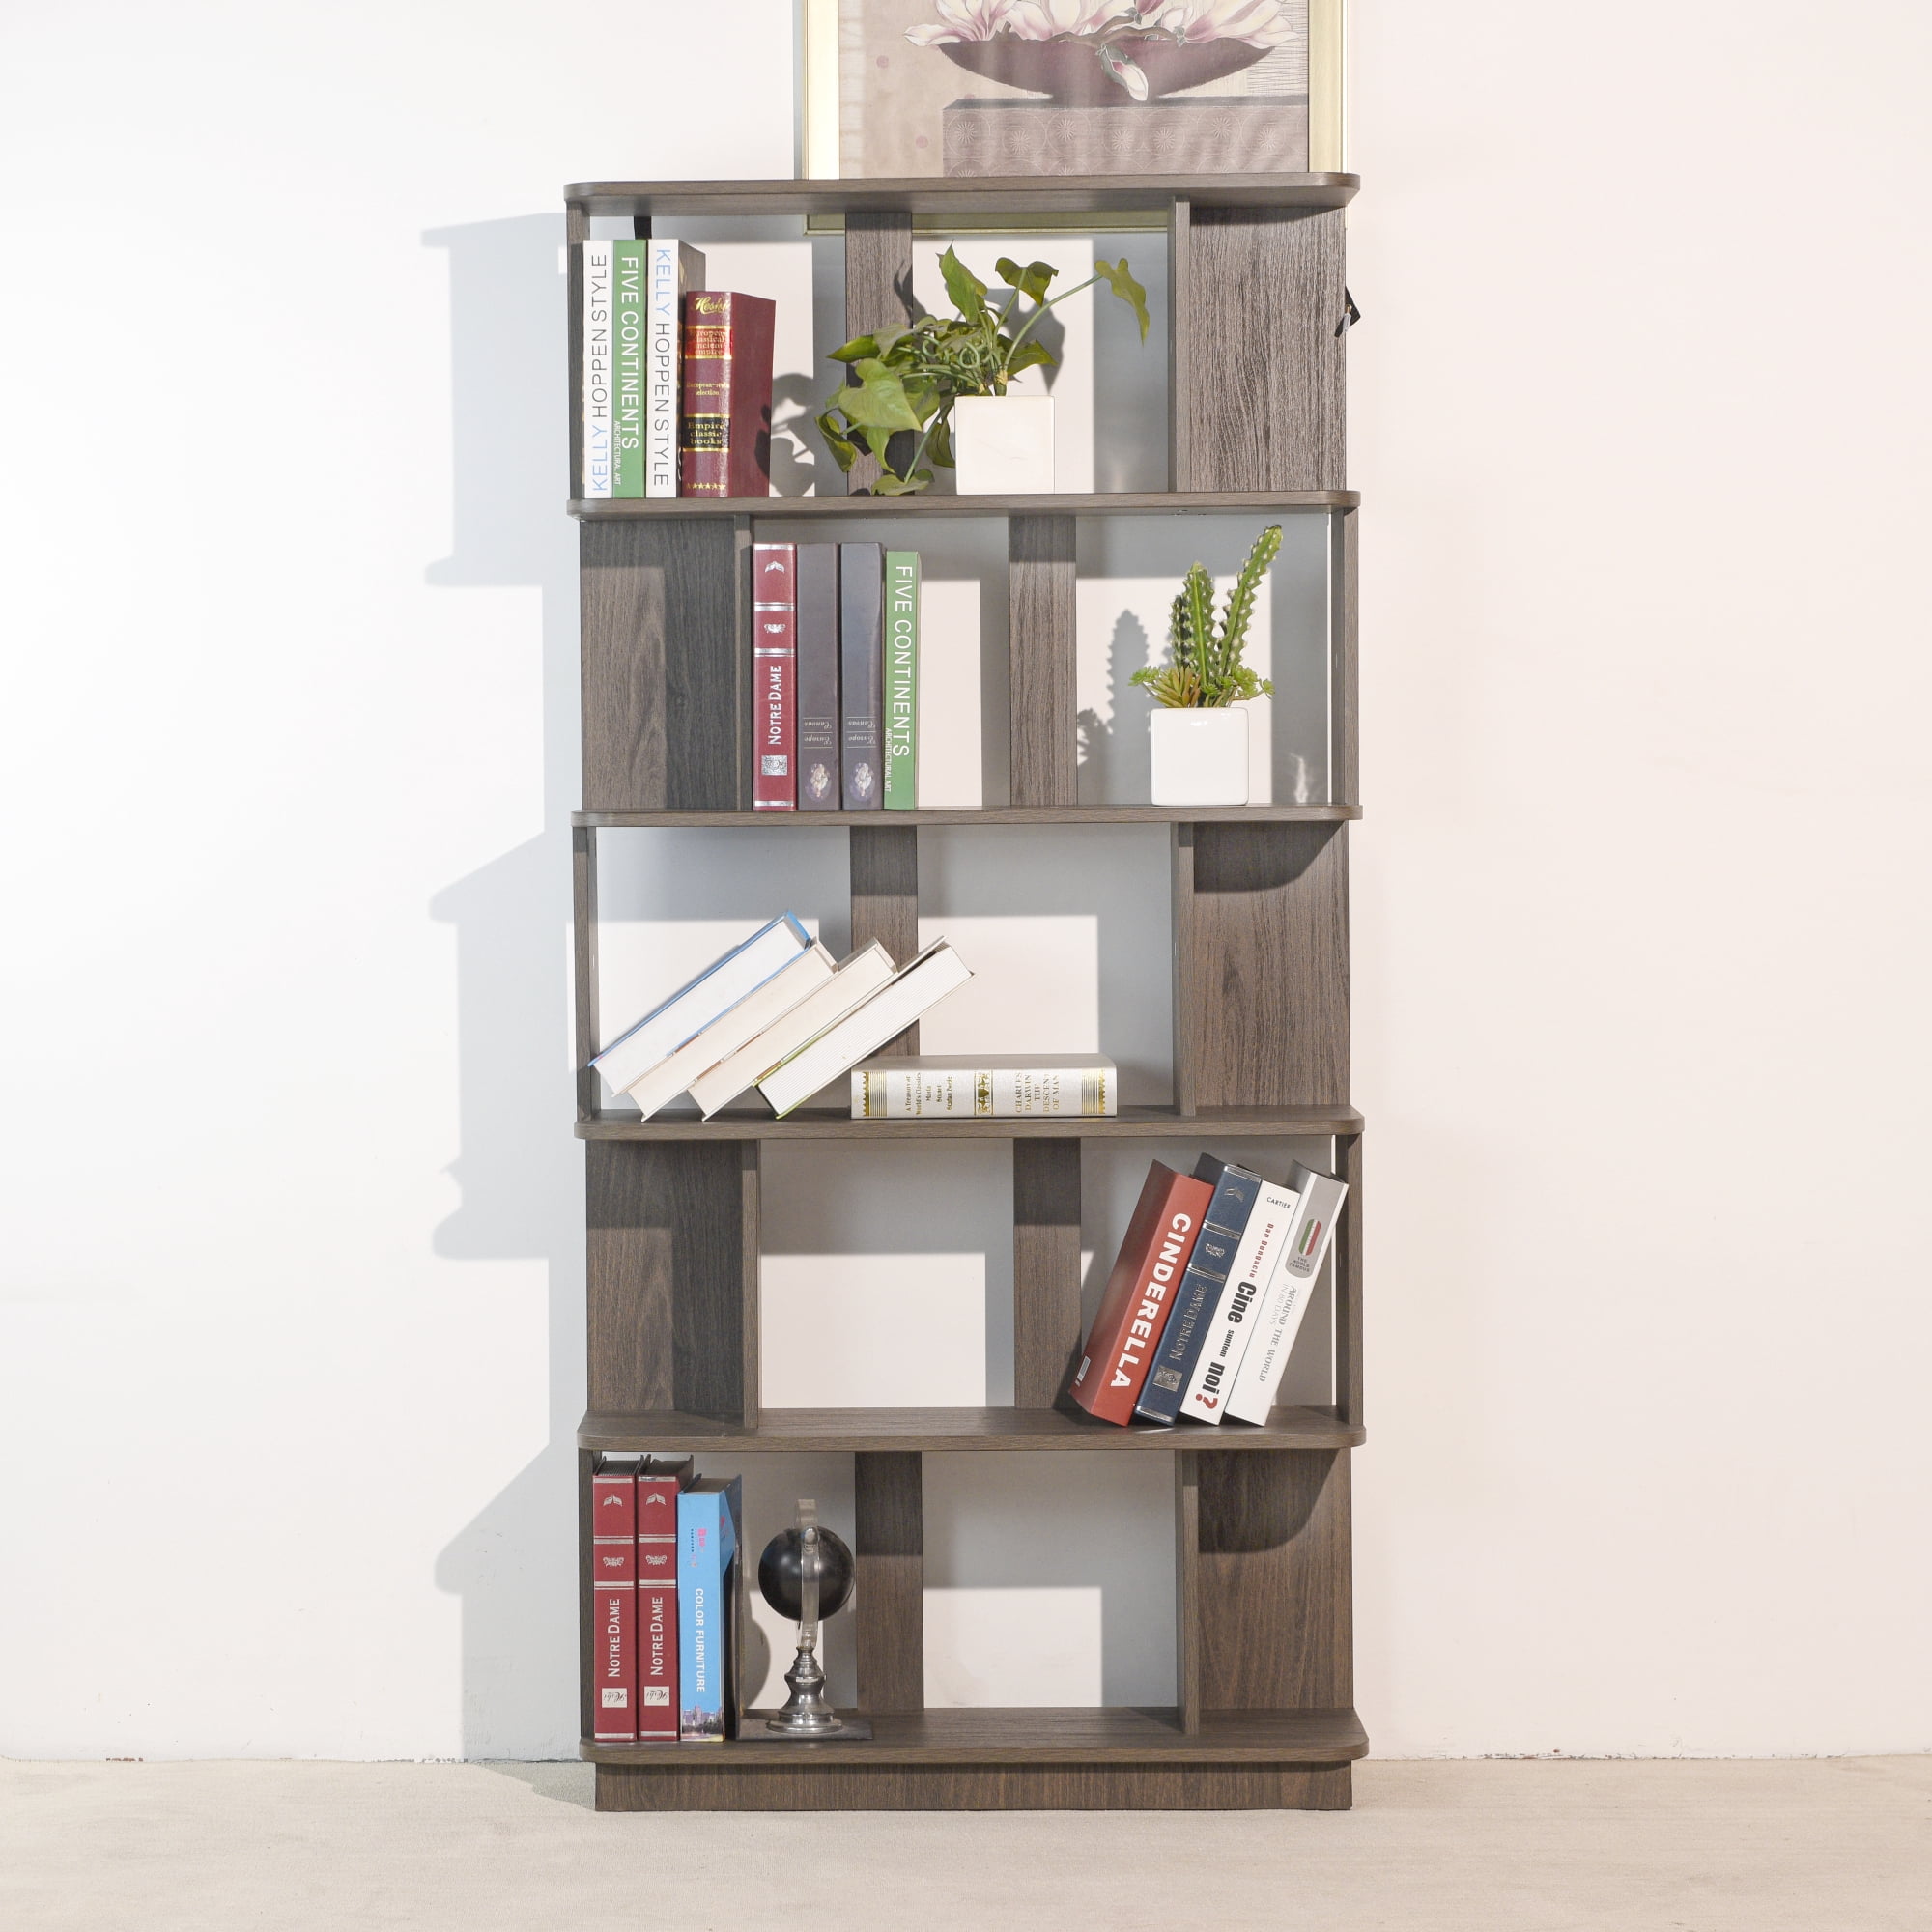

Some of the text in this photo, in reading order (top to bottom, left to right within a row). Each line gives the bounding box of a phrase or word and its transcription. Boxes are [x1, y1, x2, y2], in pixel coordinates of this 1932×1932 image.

[591, 254, 608, 491] KELLY HOPPEN STYLE
[621, 256, 639, 449] FIVE CONTINENTS
[654, 249, 671, 486] KELLY HOPPEN STYLE
[768, 665, 781, 699] DAME
[893, 566, 912, 757] FIVE CONTINENTS
[768, 703, 781, 745] NOTRE
[1052, 1097, 1059, 1110] OF
[1264, 1223, 1274, 1239] Dan
[1266, 1197, 1291, 1209] CARTIER
[1110, 1213, 1191, 1387] CINDERELLA
[1169, 1284, 1208, 1361] NOTRE DAME
[1259, 1286, 1298, 1382] AROUND THE WORLD
[1195, 1281, 1257, 1410] Cine suntem noi?
[608, 1599, 620, 1677] NOTRE DAME
[650, 1597, 664, 1676] NOTRE DAME
[696, 1588, 705, 1692] COLOR FURNITURE
